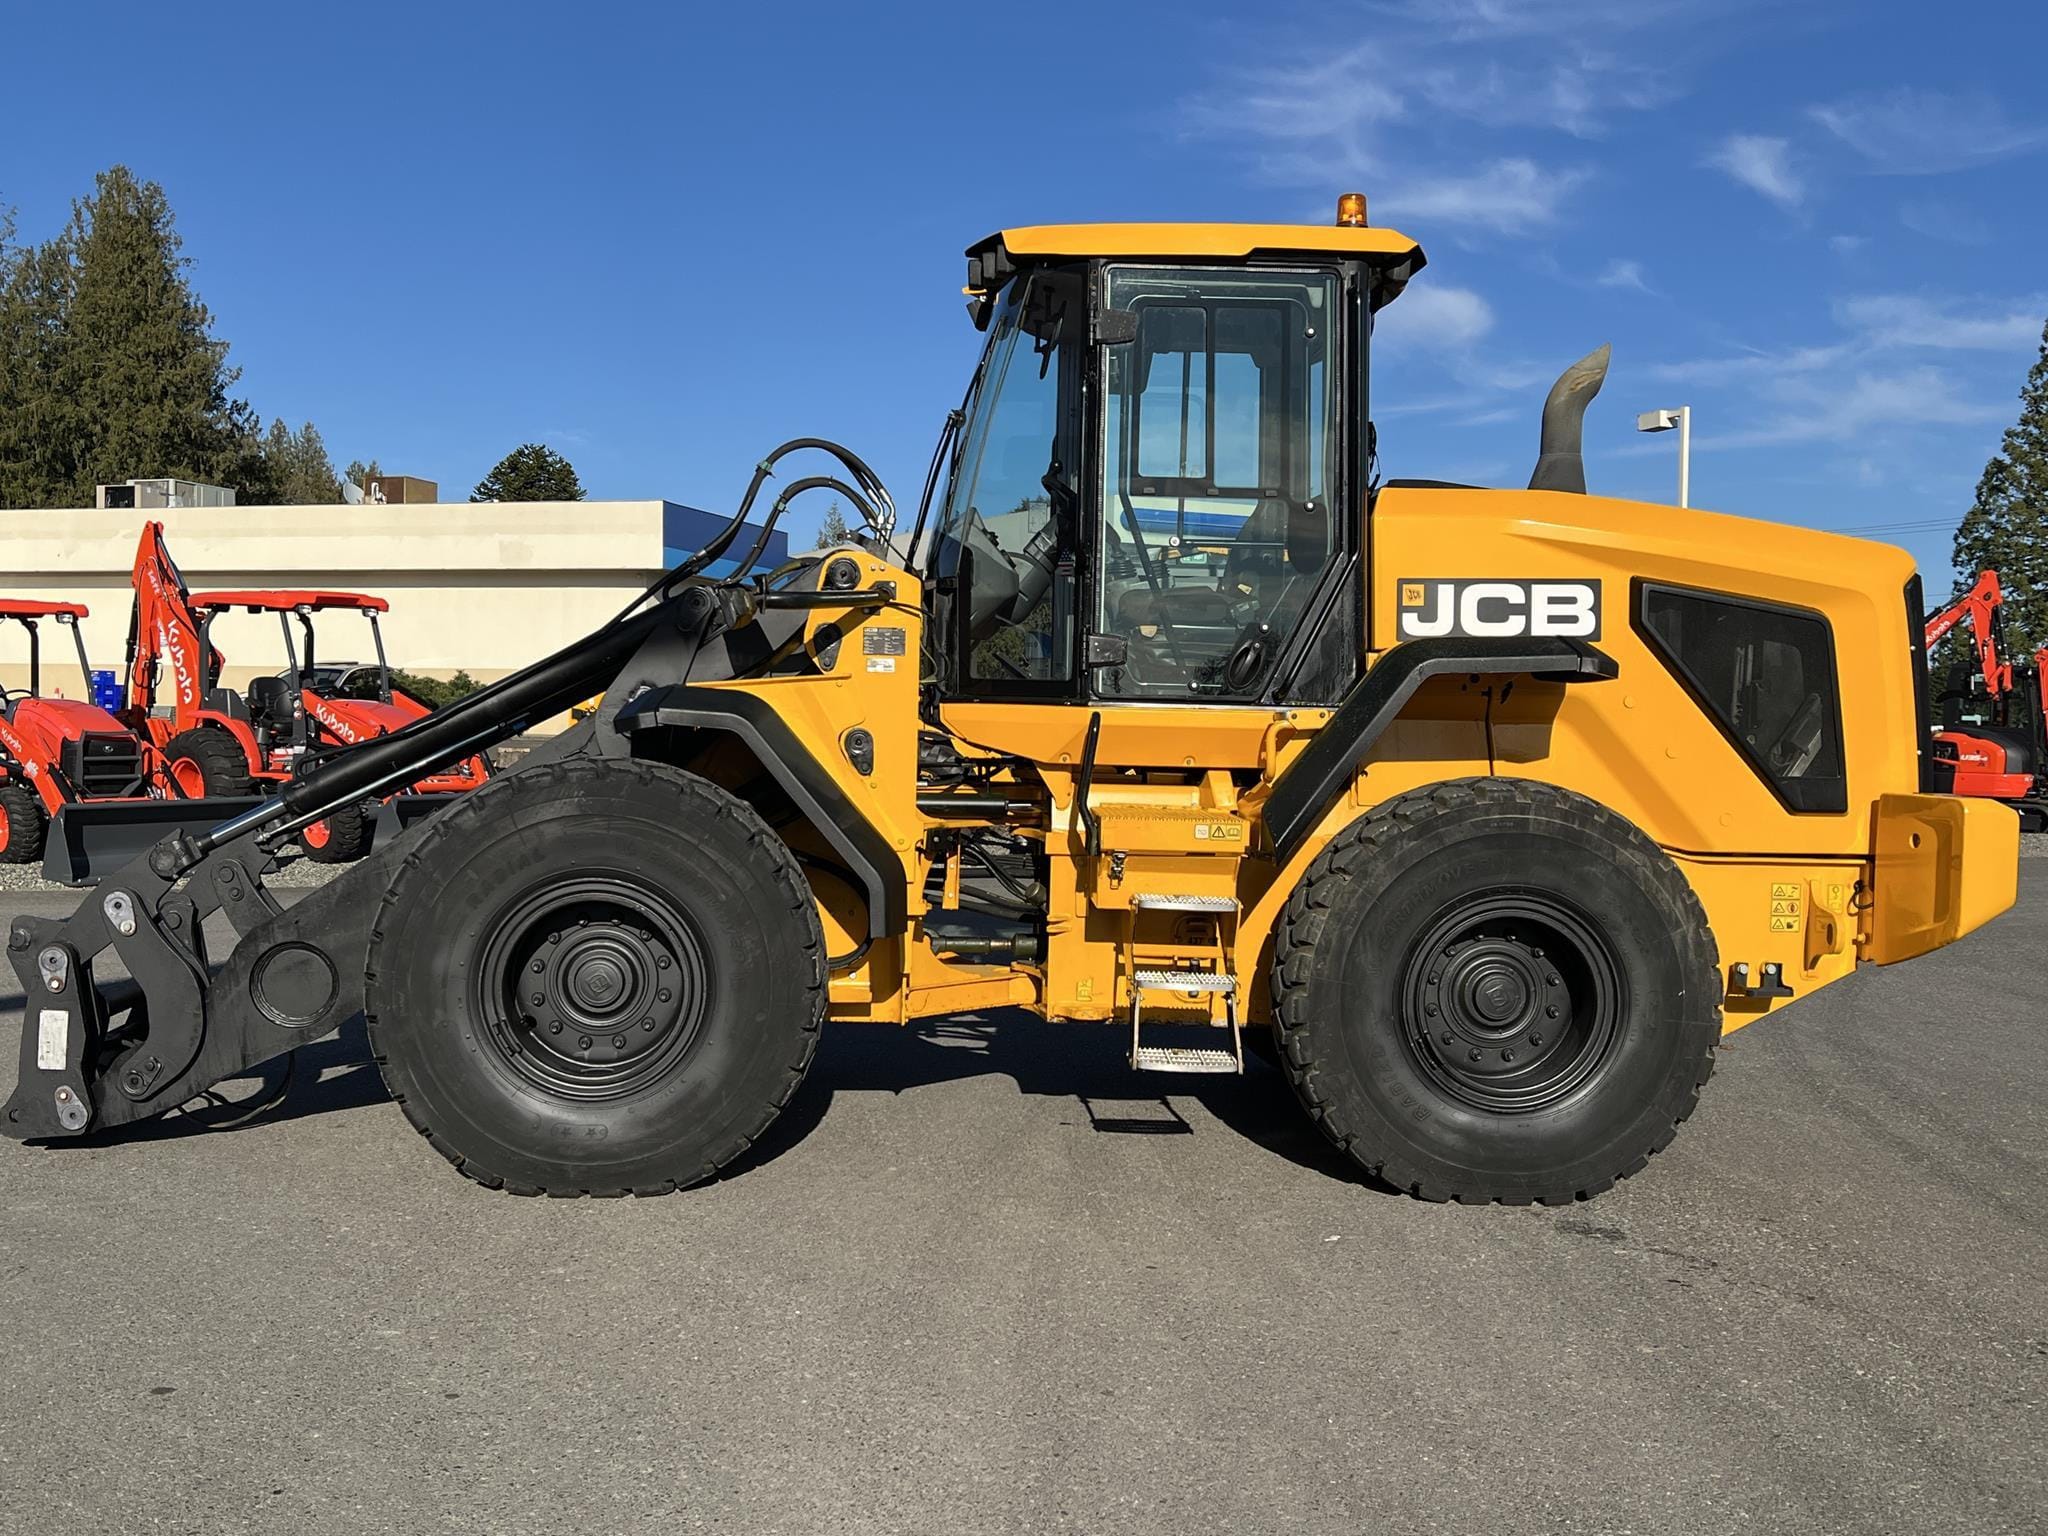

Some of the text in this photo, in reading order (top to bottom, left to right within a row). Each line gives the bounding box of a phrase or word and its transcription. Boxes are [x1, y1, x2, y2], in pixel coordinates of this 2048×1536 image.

[1402, 584, 1596, 637] JCB
[168, 619, 193, 704] Kubota
[316, 703, 355, 743] Kubota
